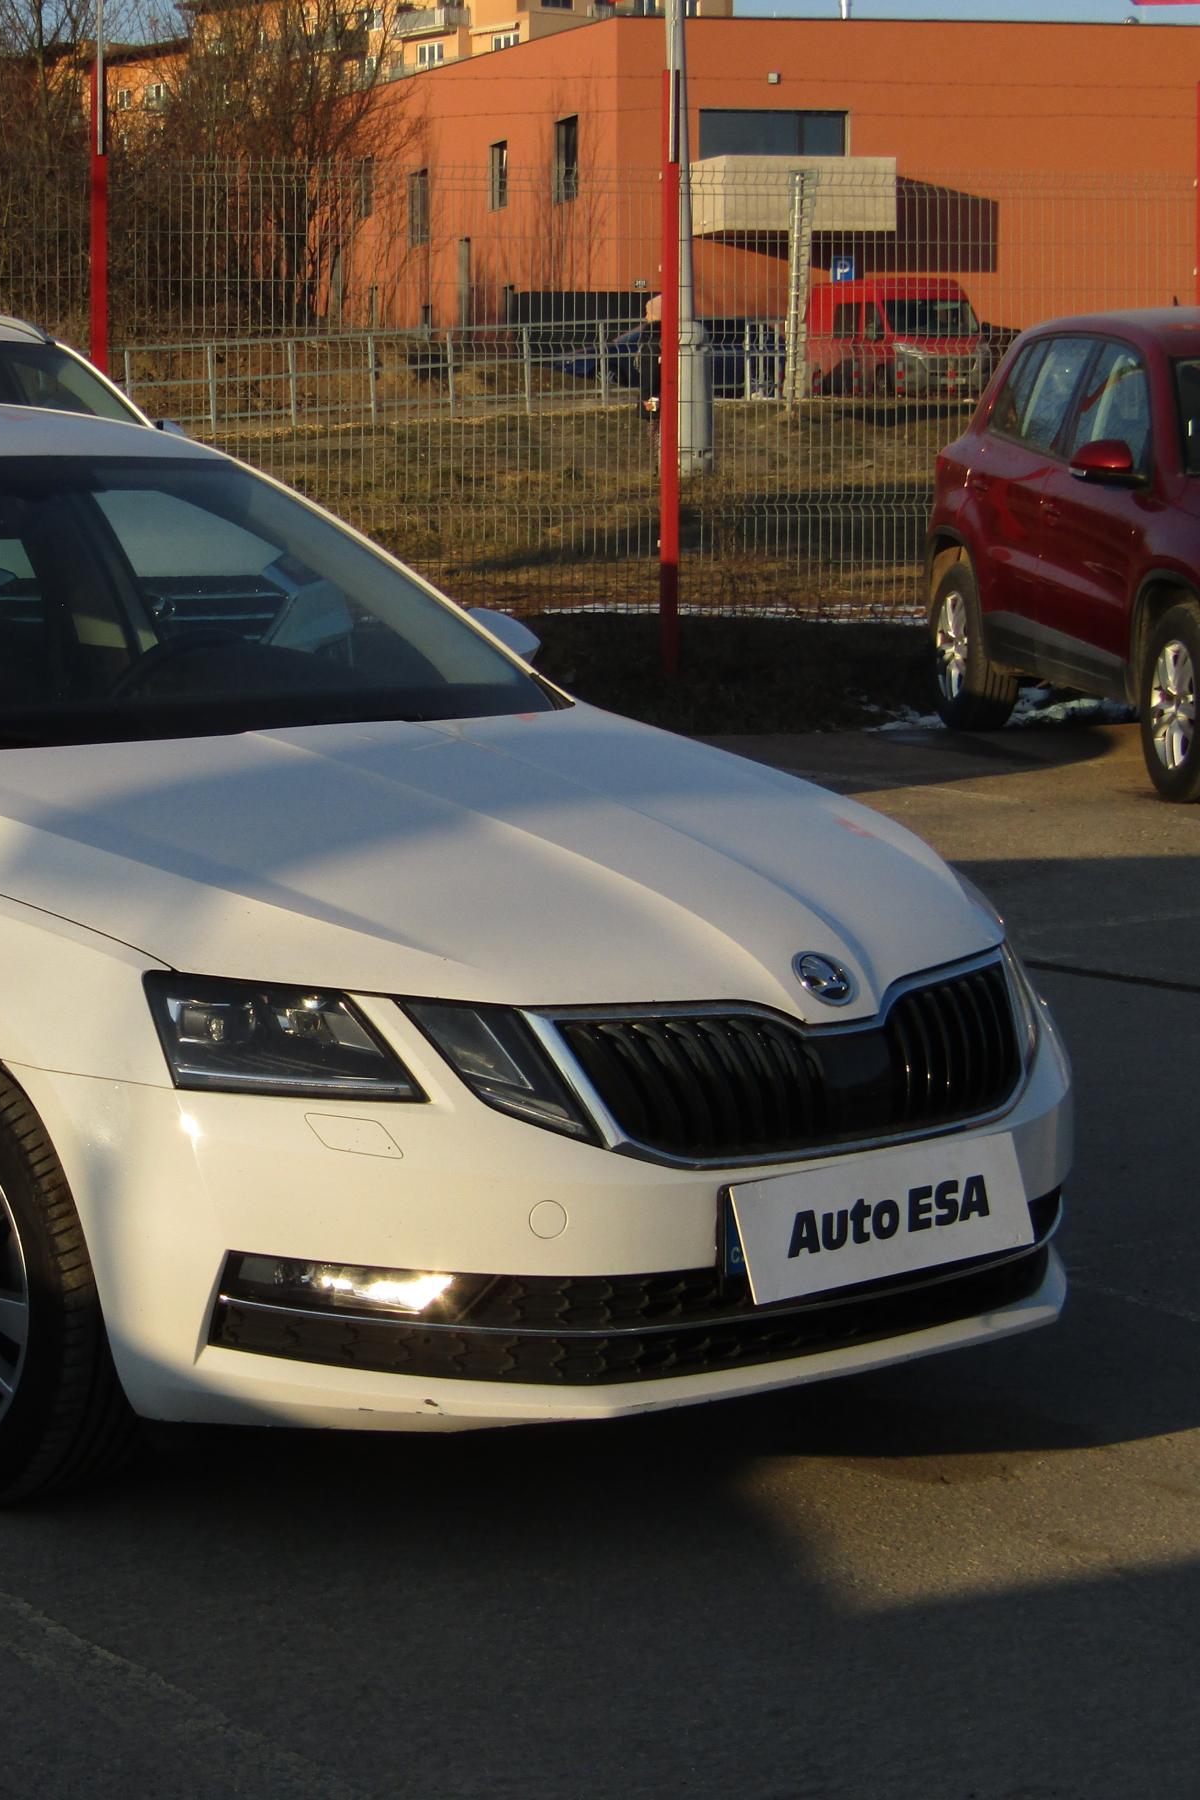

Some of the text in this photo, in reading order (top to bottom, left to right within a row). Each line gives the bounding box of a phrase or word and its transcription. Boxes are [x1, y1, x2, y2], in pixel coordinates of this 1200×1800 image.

[836, 260, 850, 280] P
[787, 1174, 990, 1259] Auto ESA
